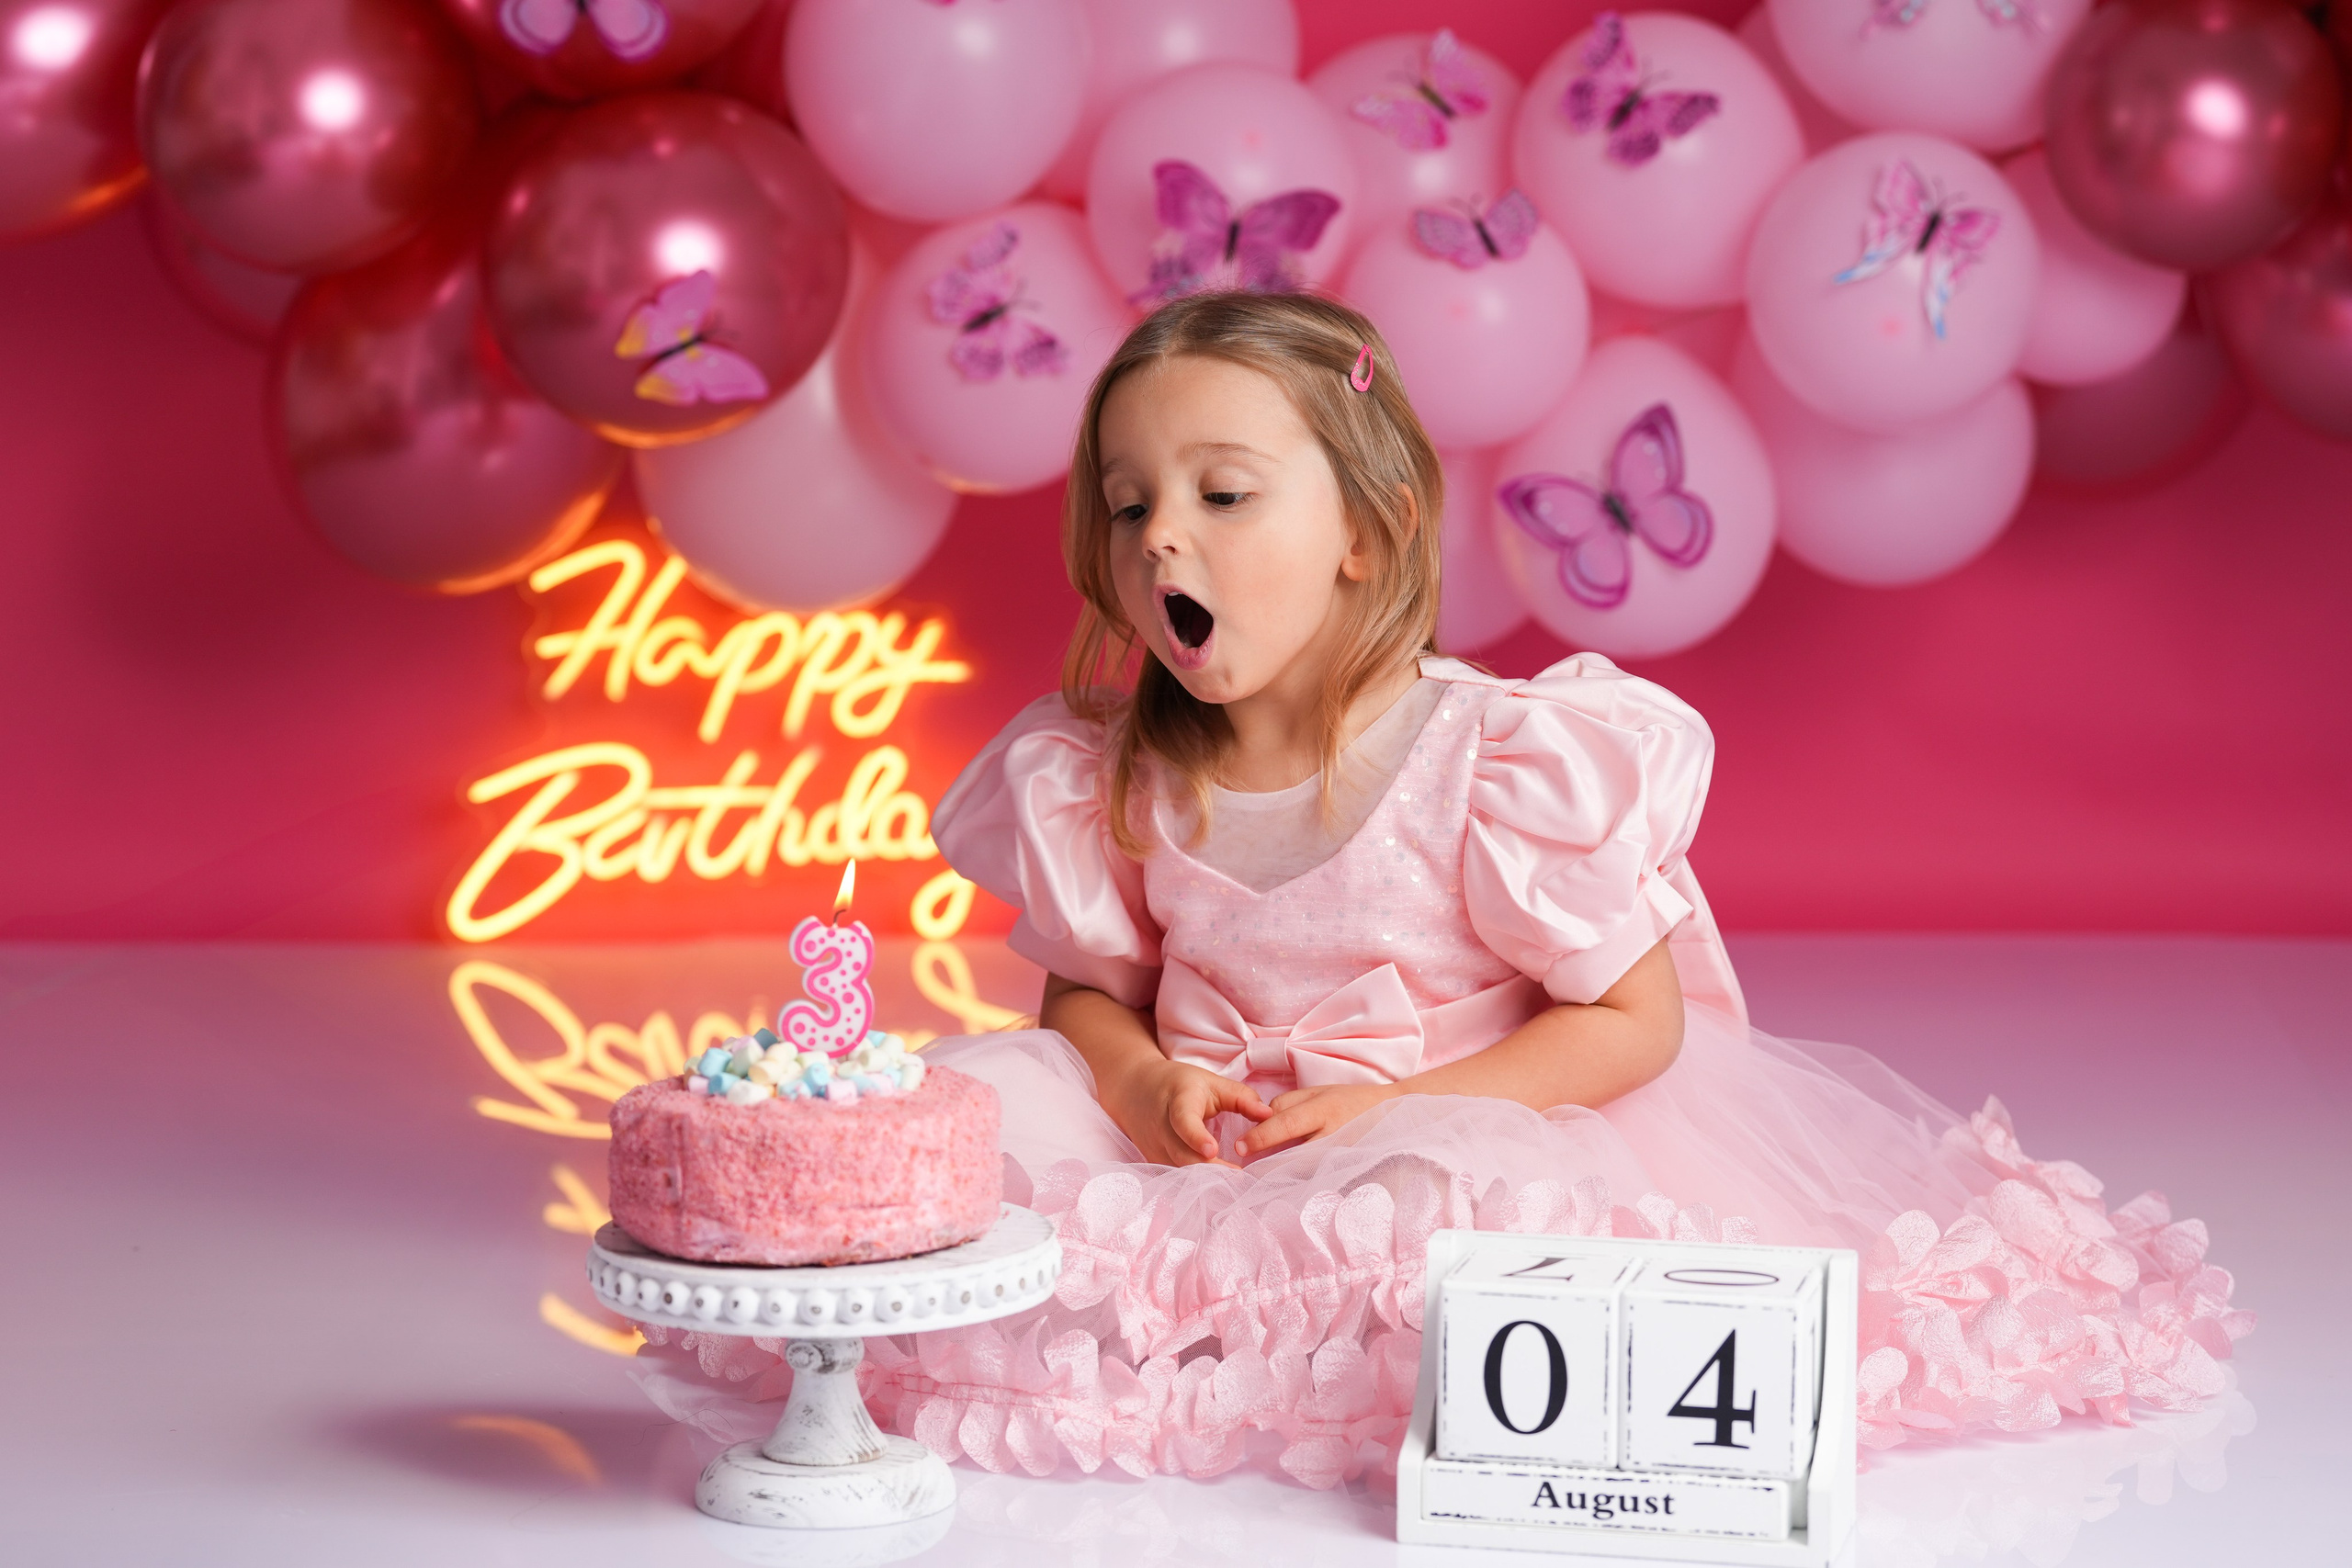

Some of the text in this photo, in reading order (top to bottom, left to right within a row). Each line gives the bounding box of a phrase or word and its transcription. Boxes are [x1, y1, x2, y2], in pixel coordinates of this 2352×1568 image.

[529, 539, 972, 744] Happy
[777, 915, 875, 1059] 3
[1531, 1481, 1675, 1520] August
